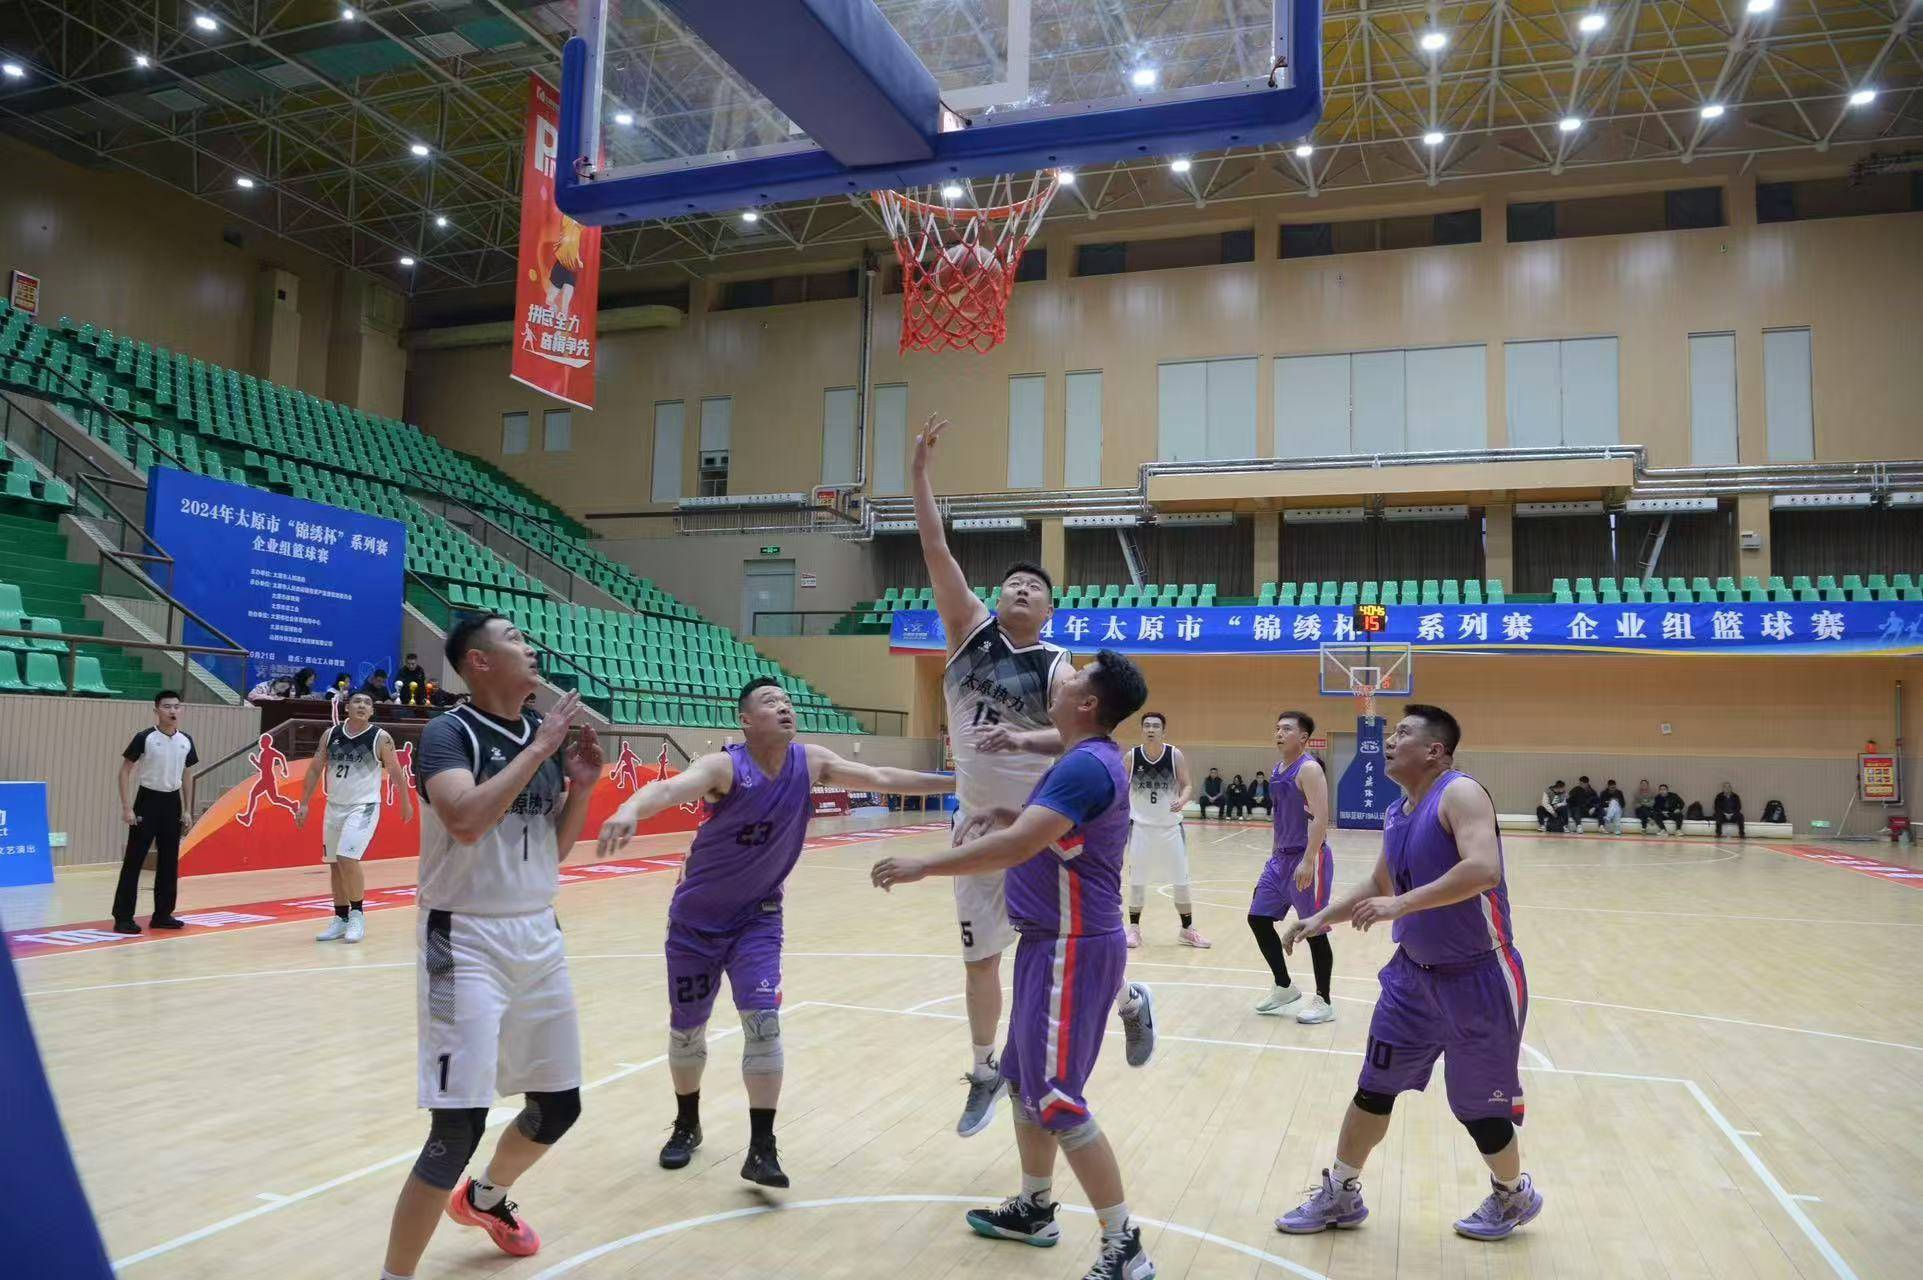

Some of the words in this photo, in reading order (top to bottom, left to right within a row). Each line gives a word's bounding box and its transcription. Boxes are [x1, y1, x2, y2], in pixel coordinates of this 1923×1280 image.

[252, 535, 330, 565] 企业组篮球赛
[1364, 615, 1380, 631] 15
[1567, 610, 1846, 641] 企业组篮球赛
[961, 673, 1025, 711] 太原热力
[972, 701, 1000, 726] 15
[336, 765, 349, 779] 21
[1150, 791, 1158, 804] 6
[522, 824, 529, 862] 1
[961, 920, 974, 948] 5
[676, 974, 711, 1004] 23
[438, 1053, 451, 1092] 1
